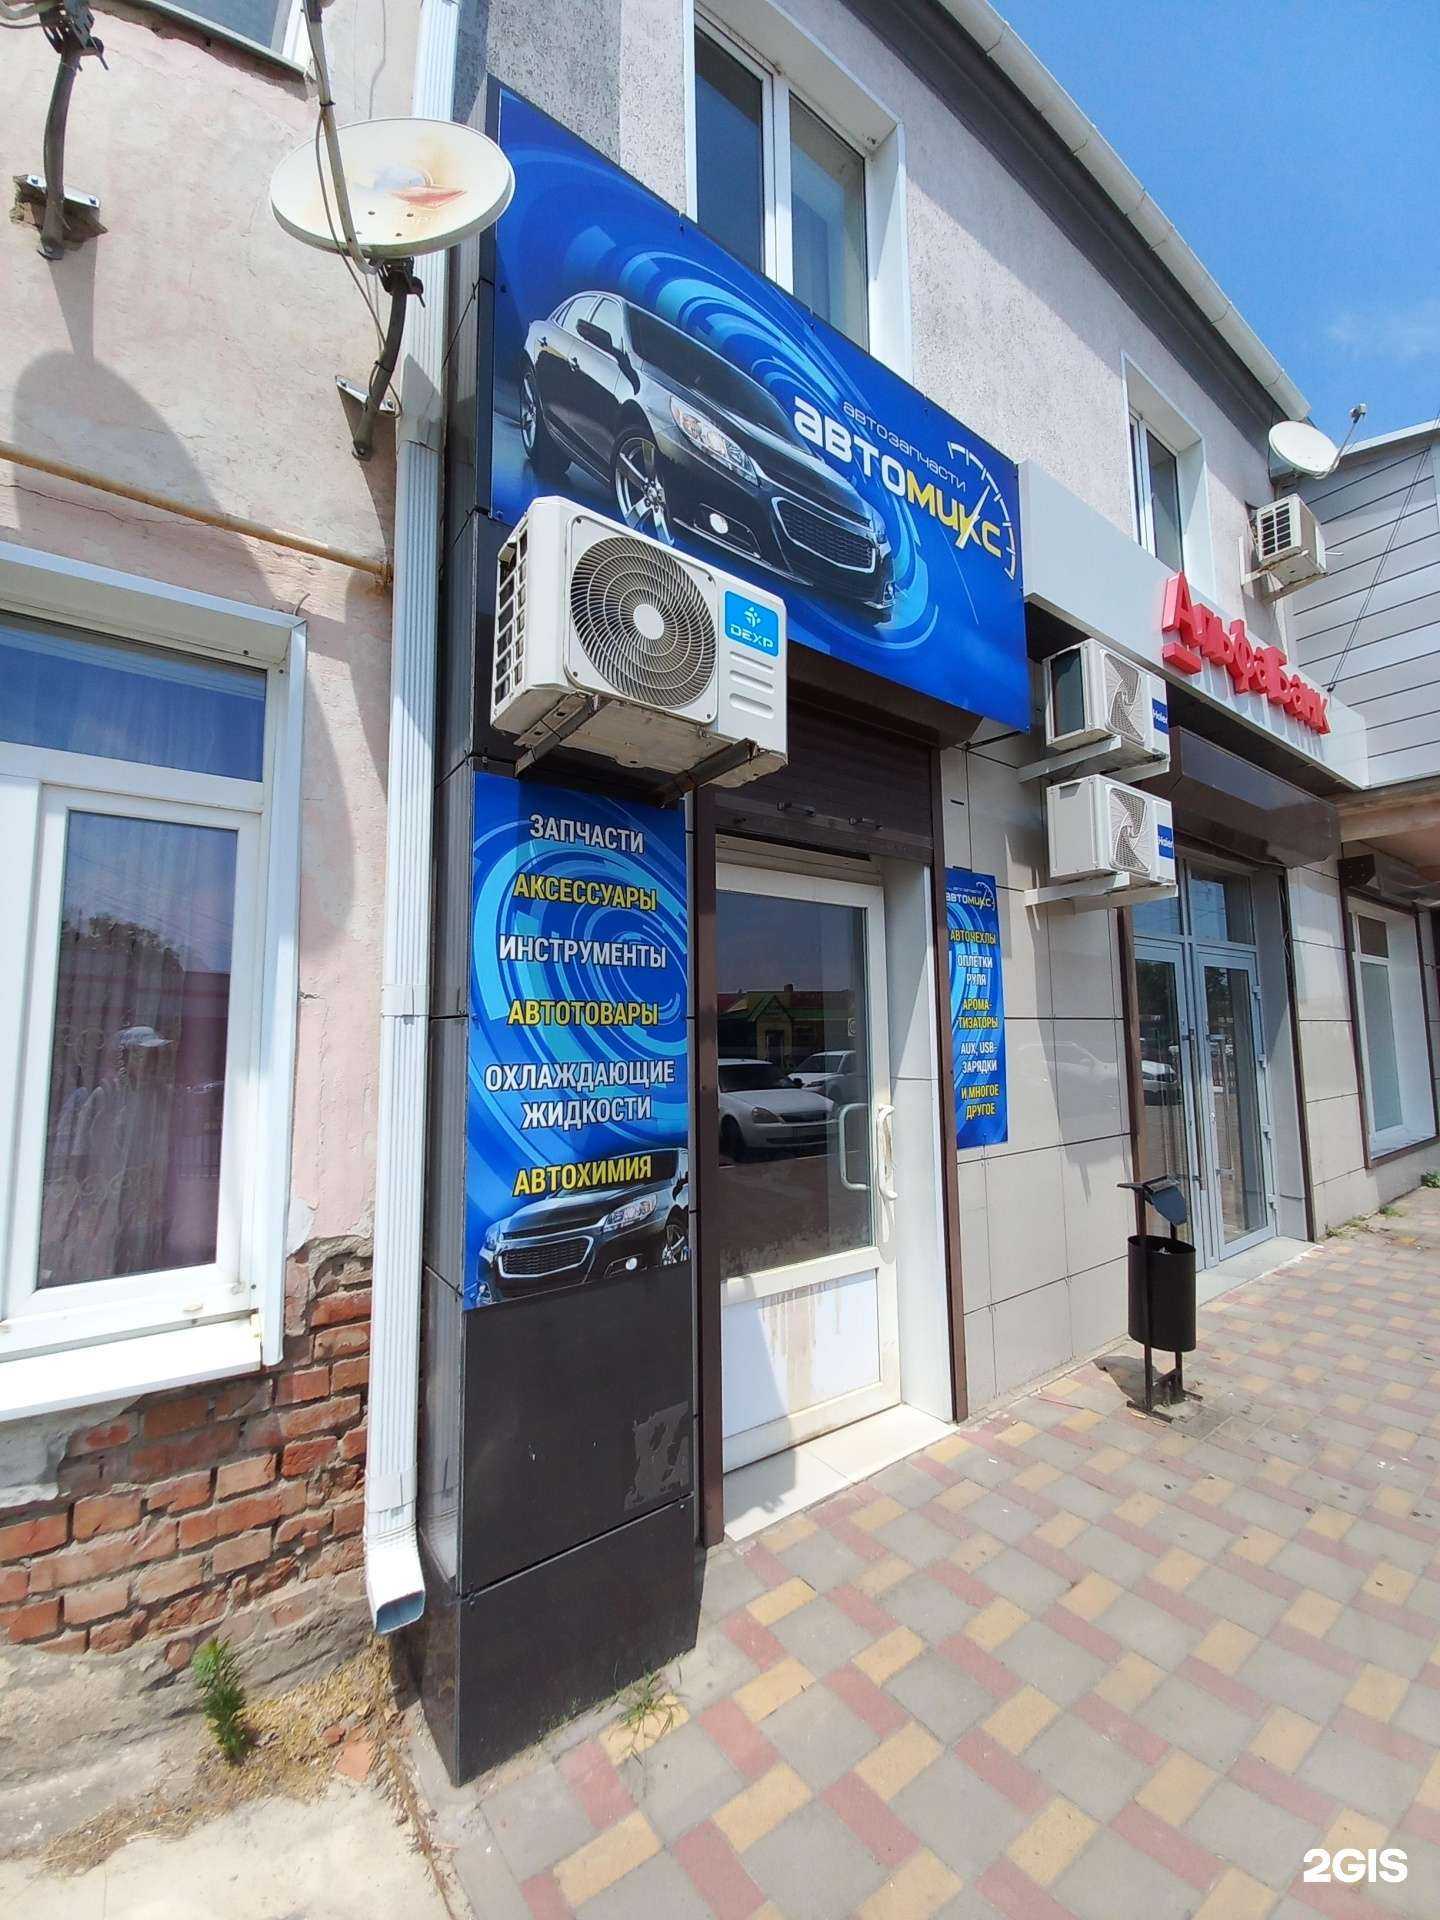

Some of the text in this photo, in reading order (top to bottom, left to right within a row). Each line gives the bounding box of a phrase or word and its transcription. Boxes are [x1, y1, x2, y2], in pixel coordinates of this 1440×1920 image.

[843, 401, 966, 493] автозапчасти
[730, 624, 774, 648] DEXP
[529, 814, 645, 854] ЗАПЧАСТИ
[513, 873, 657, 911] АКСЕССУАРЫ
[950, 929, 996, 945] АВТОЧЕХЛЫ
[499, 934, 667, 968] ИНСТРУМЕНТЫ
[966, 973, 987, 986] РУЛЯ
[507, 1001, 659, 1026] АВТОТОВАРЫ
[963, 998, 992, 1010] АРОМА-
[958, 1016, 999, 1029] ТИЗАТОРЫ
[960, 1041, 998, 1056] AUX, USB-
[484, 1060, 675, 1093] ОХЛАЖДАЮЩИЕ
[962, 1060, 998, 1075] ЗАРЯДКИ
[961, 1084, 999, 1100] И МНОГОЕ
[520, 1096, 652, 1130] ЖИДКОСТИ
[966, 1103, 995, 1120] ДРУГОЕ
[513, 1155, 652, 1198] АВТОХИМИЯ
